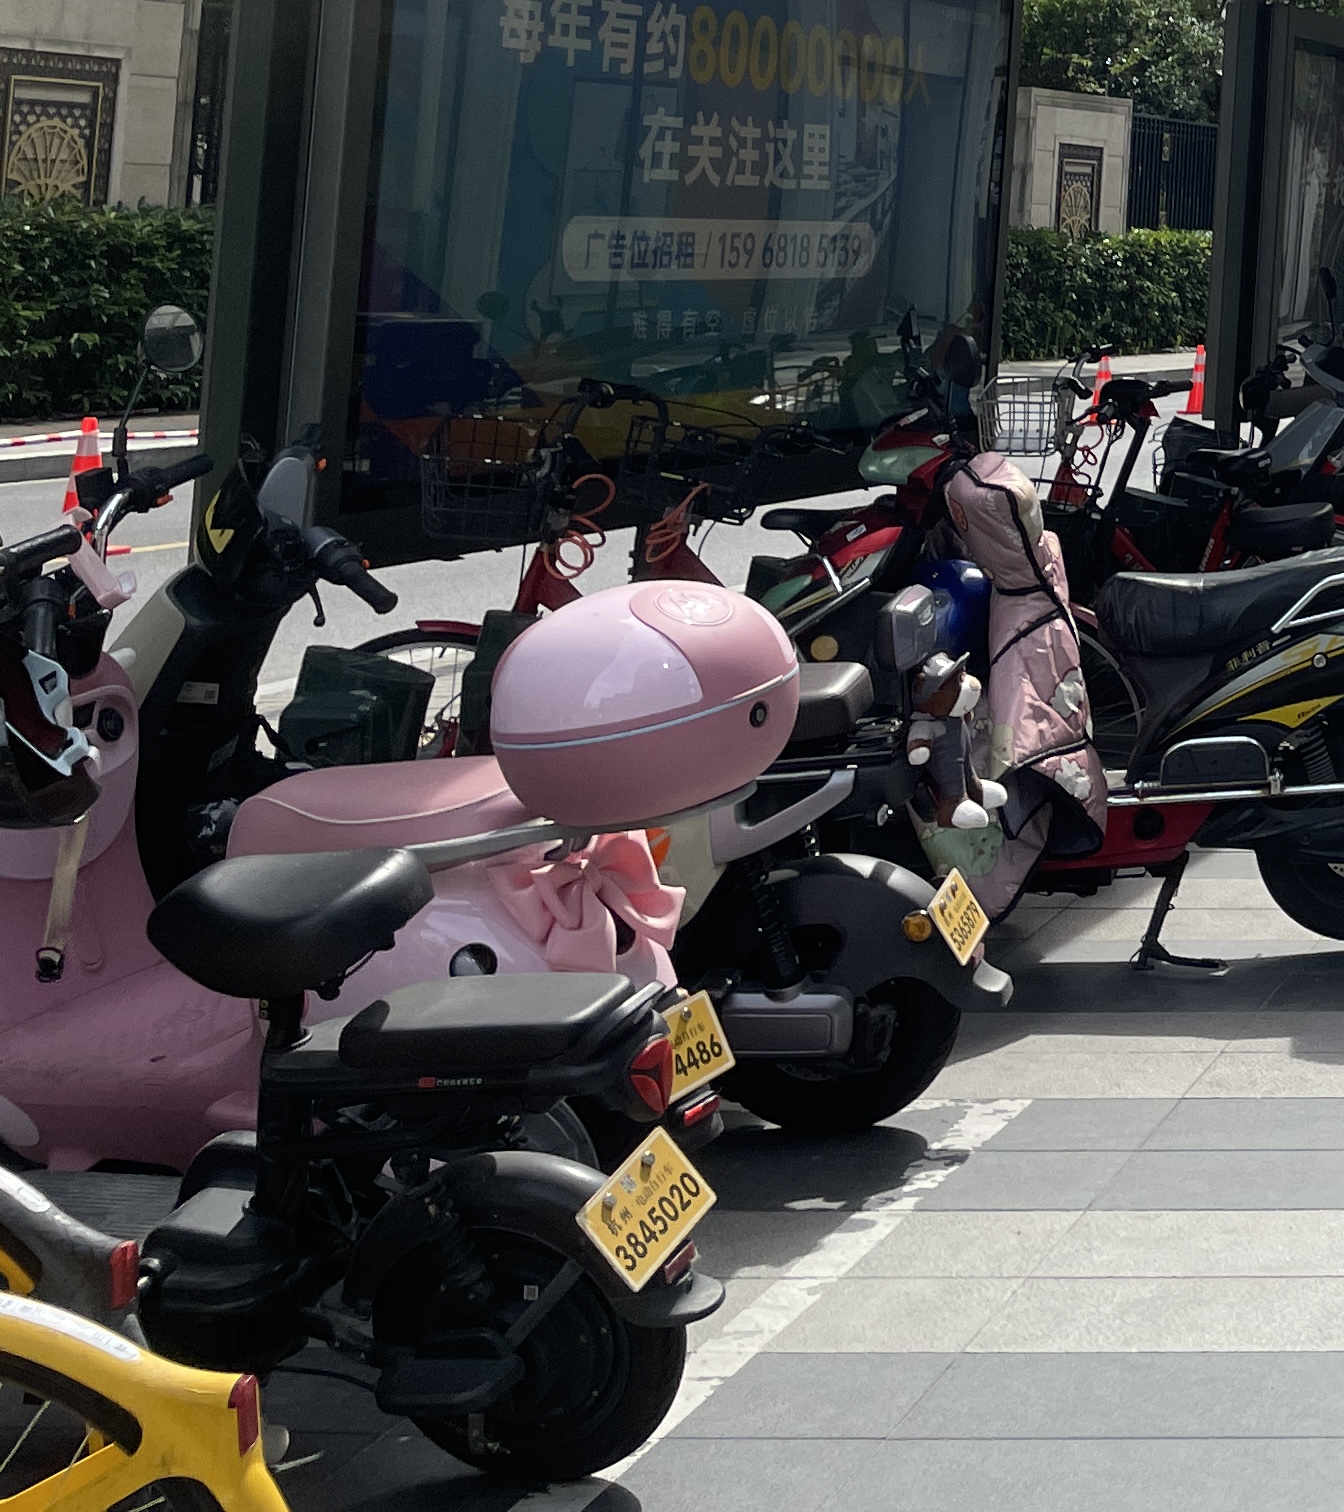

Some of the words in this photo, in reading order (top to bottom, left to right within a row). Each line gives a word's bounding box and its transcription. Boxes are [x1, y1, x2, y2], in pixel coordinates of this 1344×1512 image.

[639, 106, 832, 190] 在关注这里
[585, 230, 695, 270] 广告位招租
[718, 231, 756, 269] 159
[615, 1172, 700, 1272] 3845020
